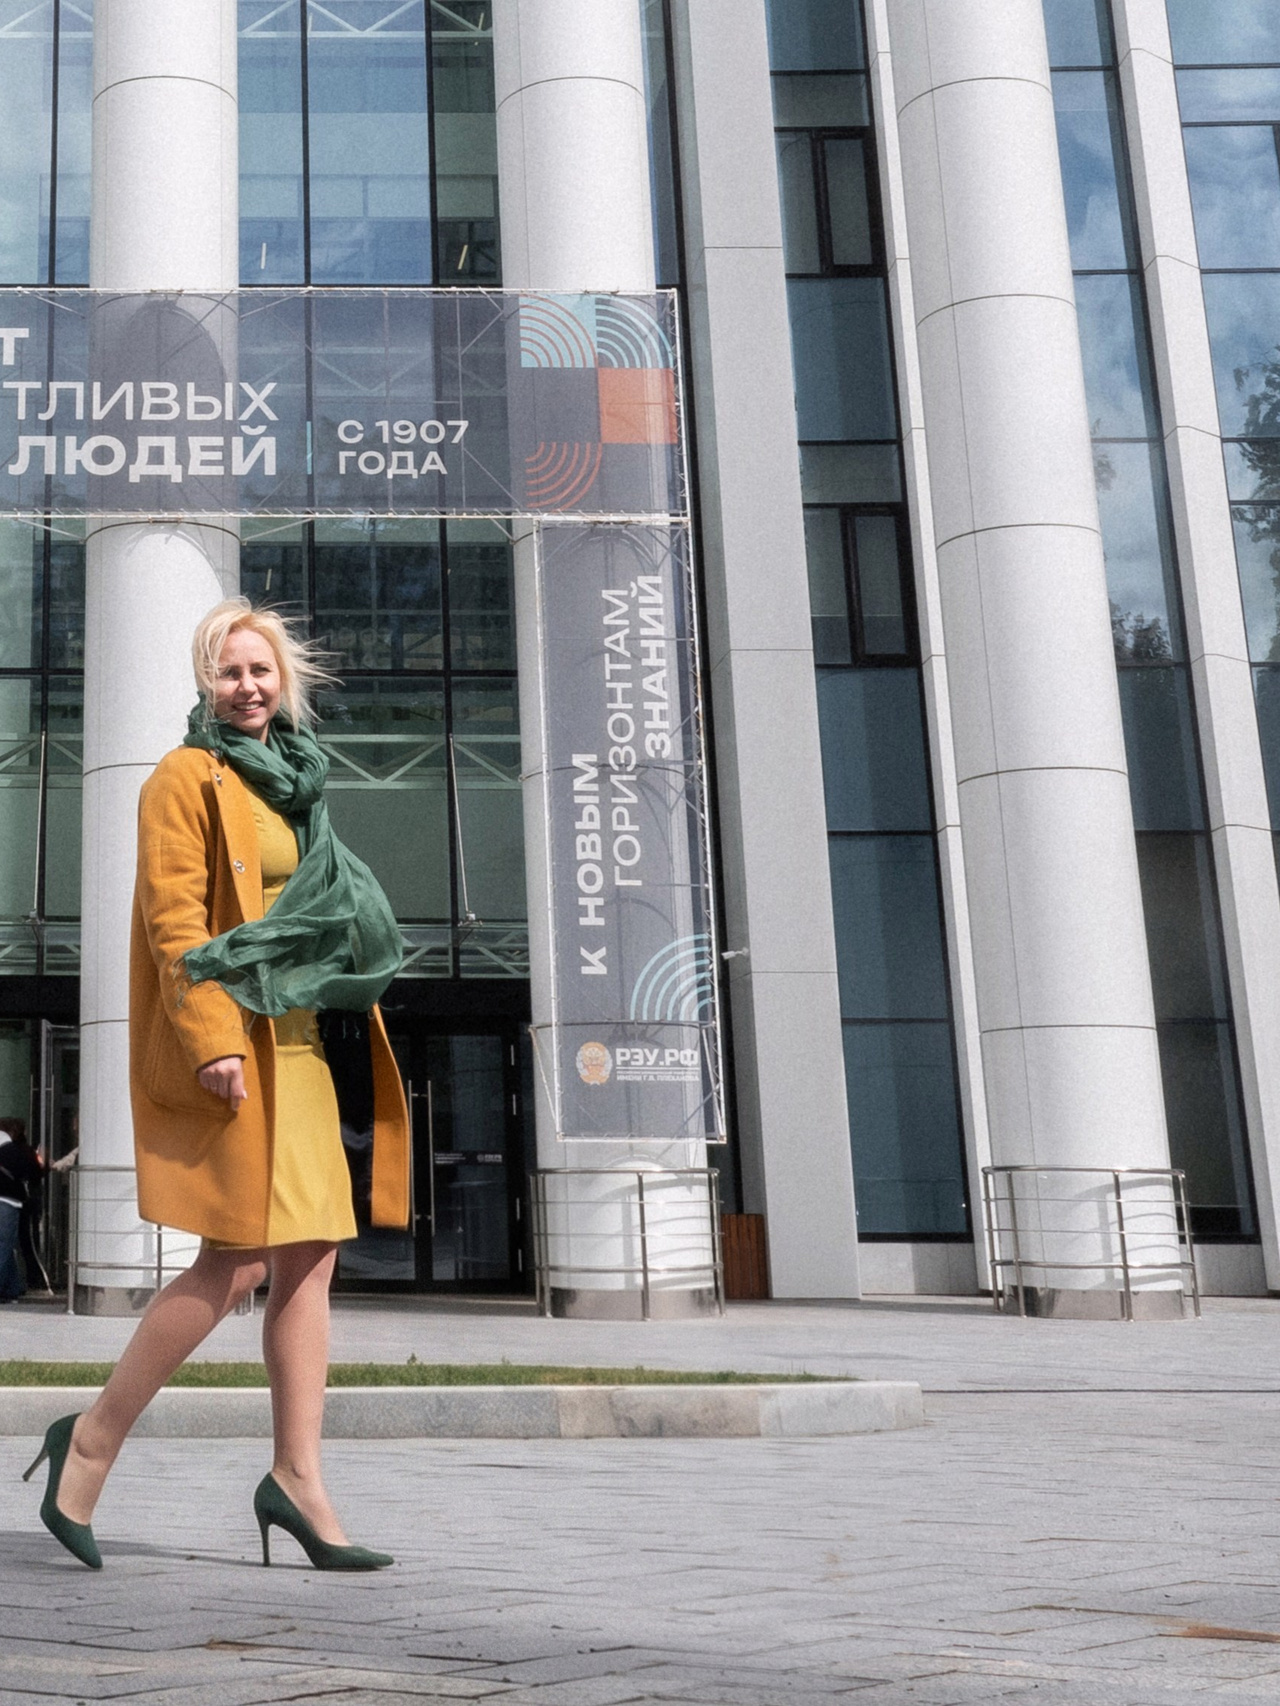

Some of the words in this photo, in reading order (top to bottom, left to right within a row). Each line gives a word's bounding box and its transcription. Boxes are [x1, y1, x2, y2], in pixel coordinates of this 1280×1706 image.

[7, 424, 278, 484] ЛЮДЕЙ
[336, 420, 365, 445] С
[374, 420, 470, 445] 1907
[337, 450, 449, 480] ГОДА
[628, 575, 672, 760] ЗНАНИЙ
[601, 589, 643, 887] ГОРИЗОНТАМ
[571, 753, 606, 927] НОВЫМ
[580, 945, 608, 976] К
[615, 1047, 700, 1067] РЭУ.РФ
